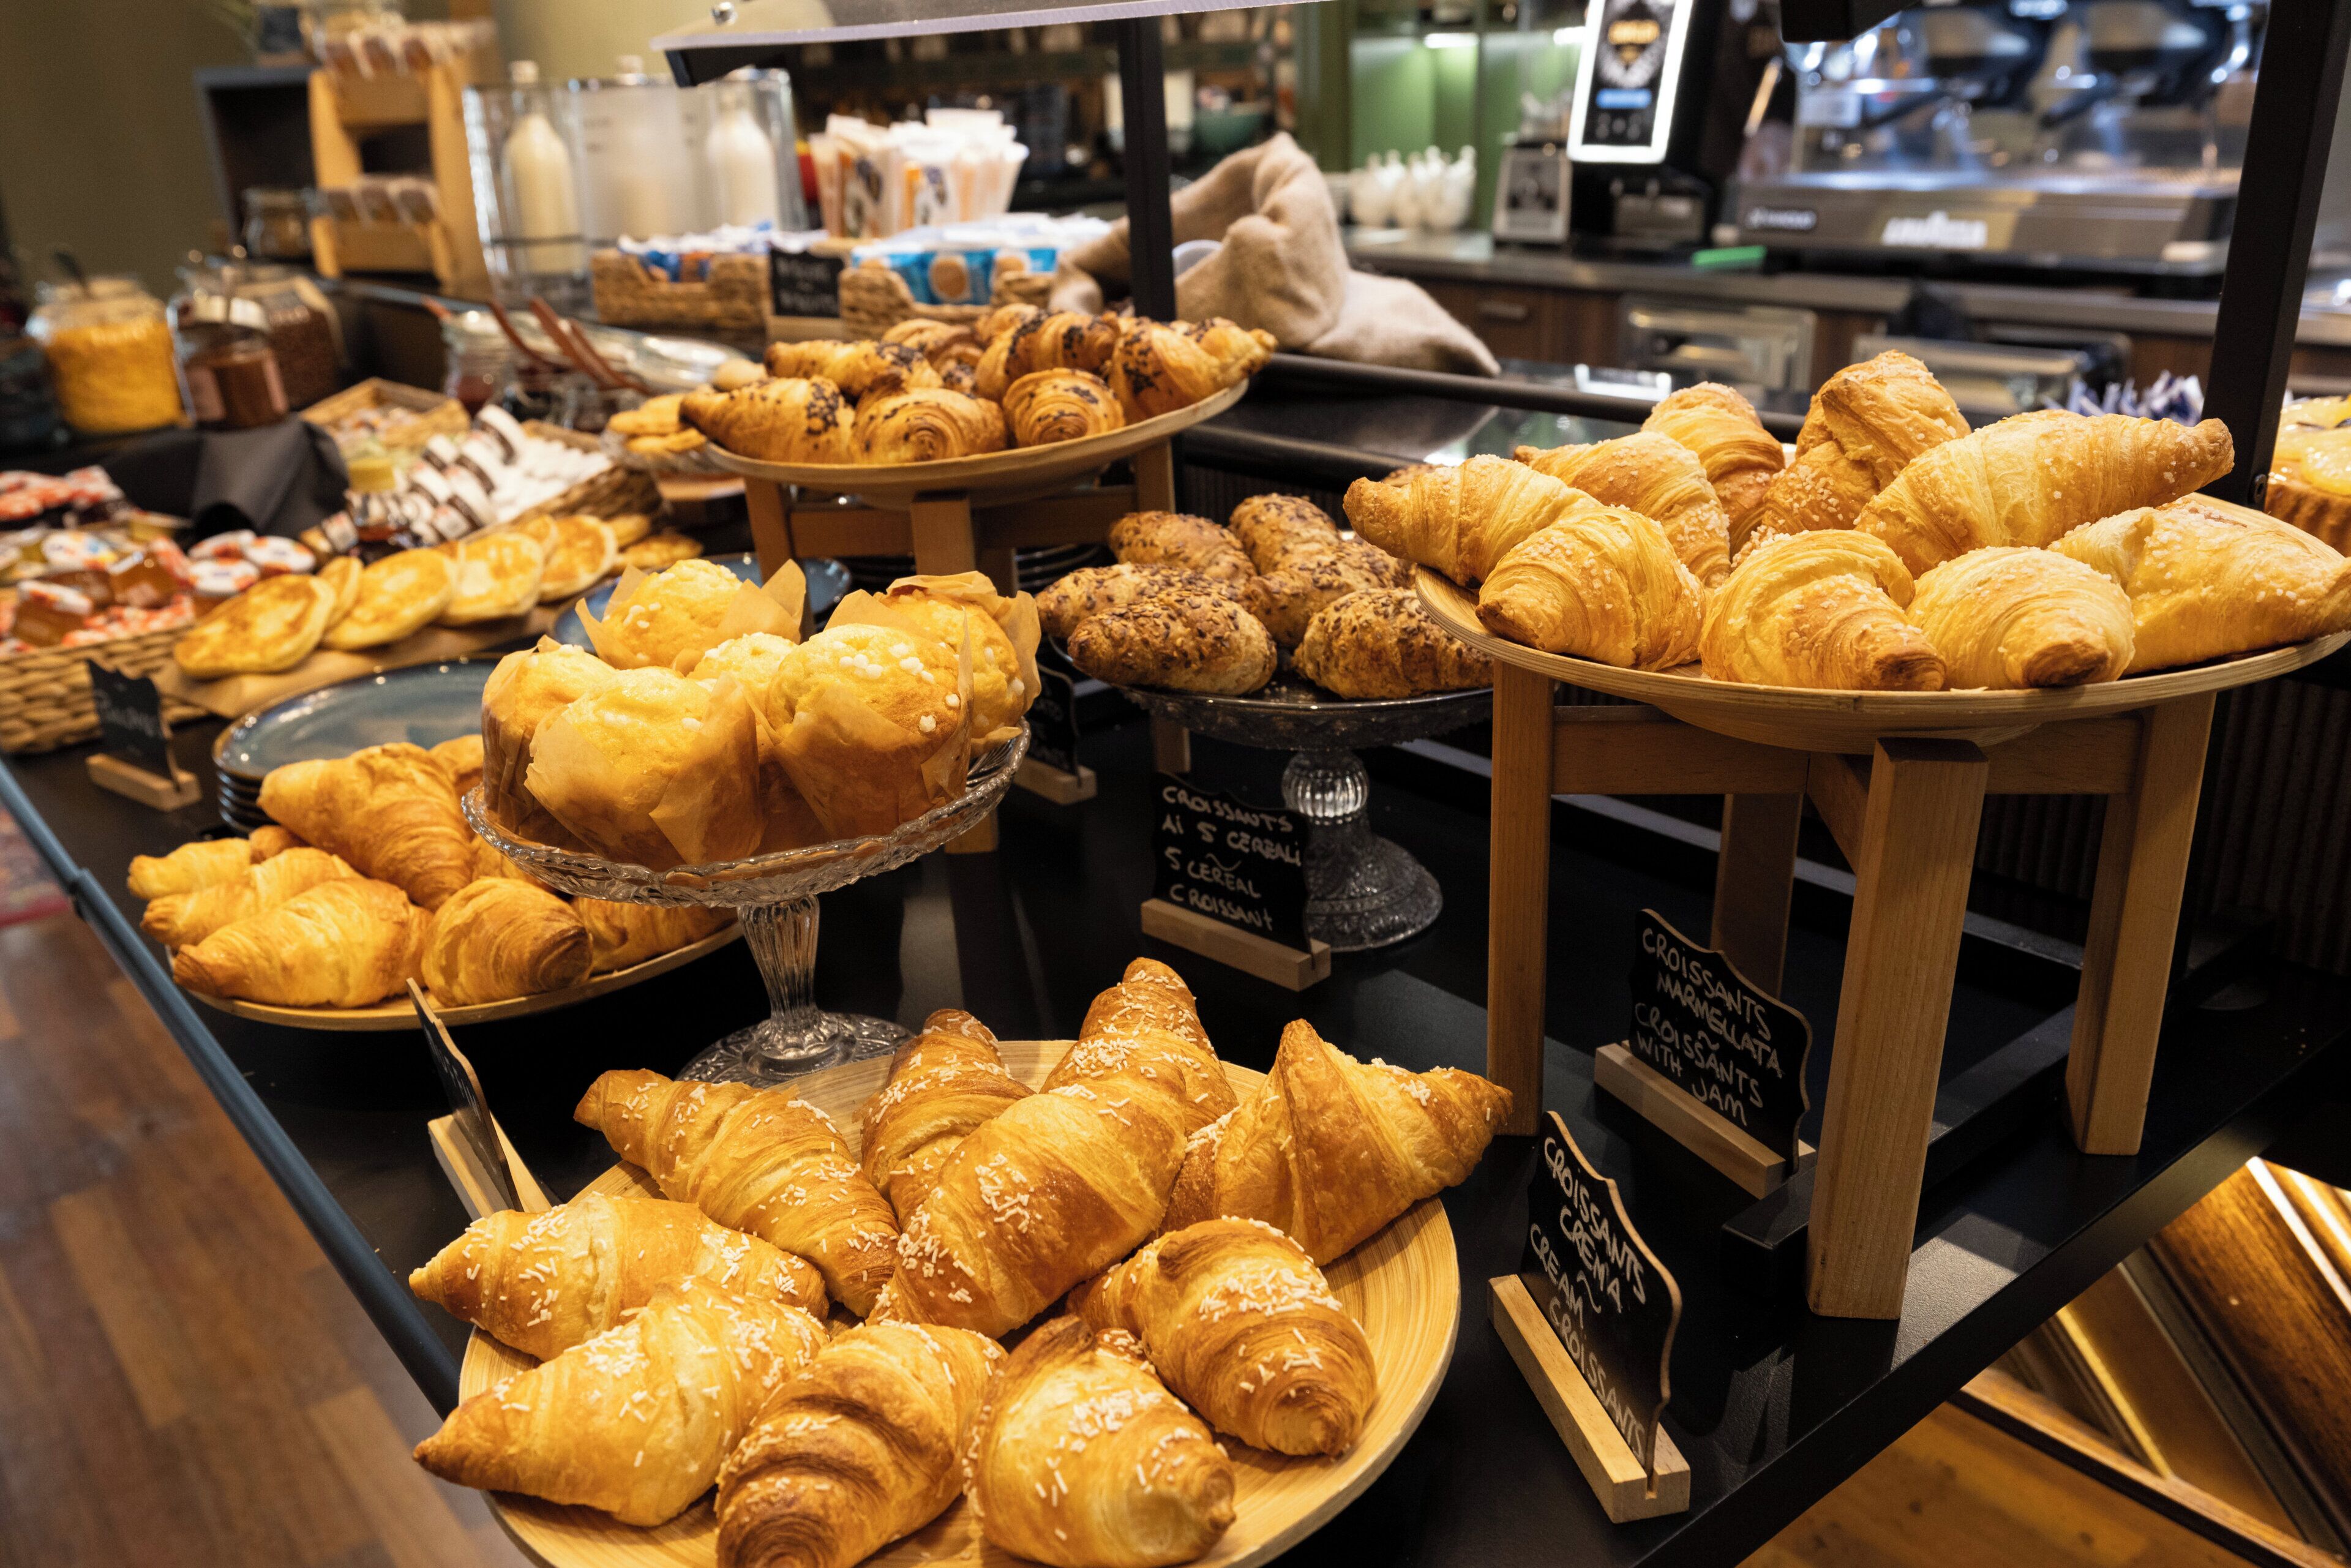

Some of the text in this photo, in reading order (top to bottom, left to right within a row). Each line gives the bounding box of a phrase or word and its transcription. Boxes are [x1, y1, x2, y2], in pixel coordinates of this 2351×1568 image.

[1187, 860, 1262, 899] CEREAL
[1657, 971, 1786, 1079] MARMELLATA
[1692, 1078, 1747, 1126] JAM
[1531, 1223, 1584, 1329] CREAM
[1559, 1204, 1622, 1313] CREMA
